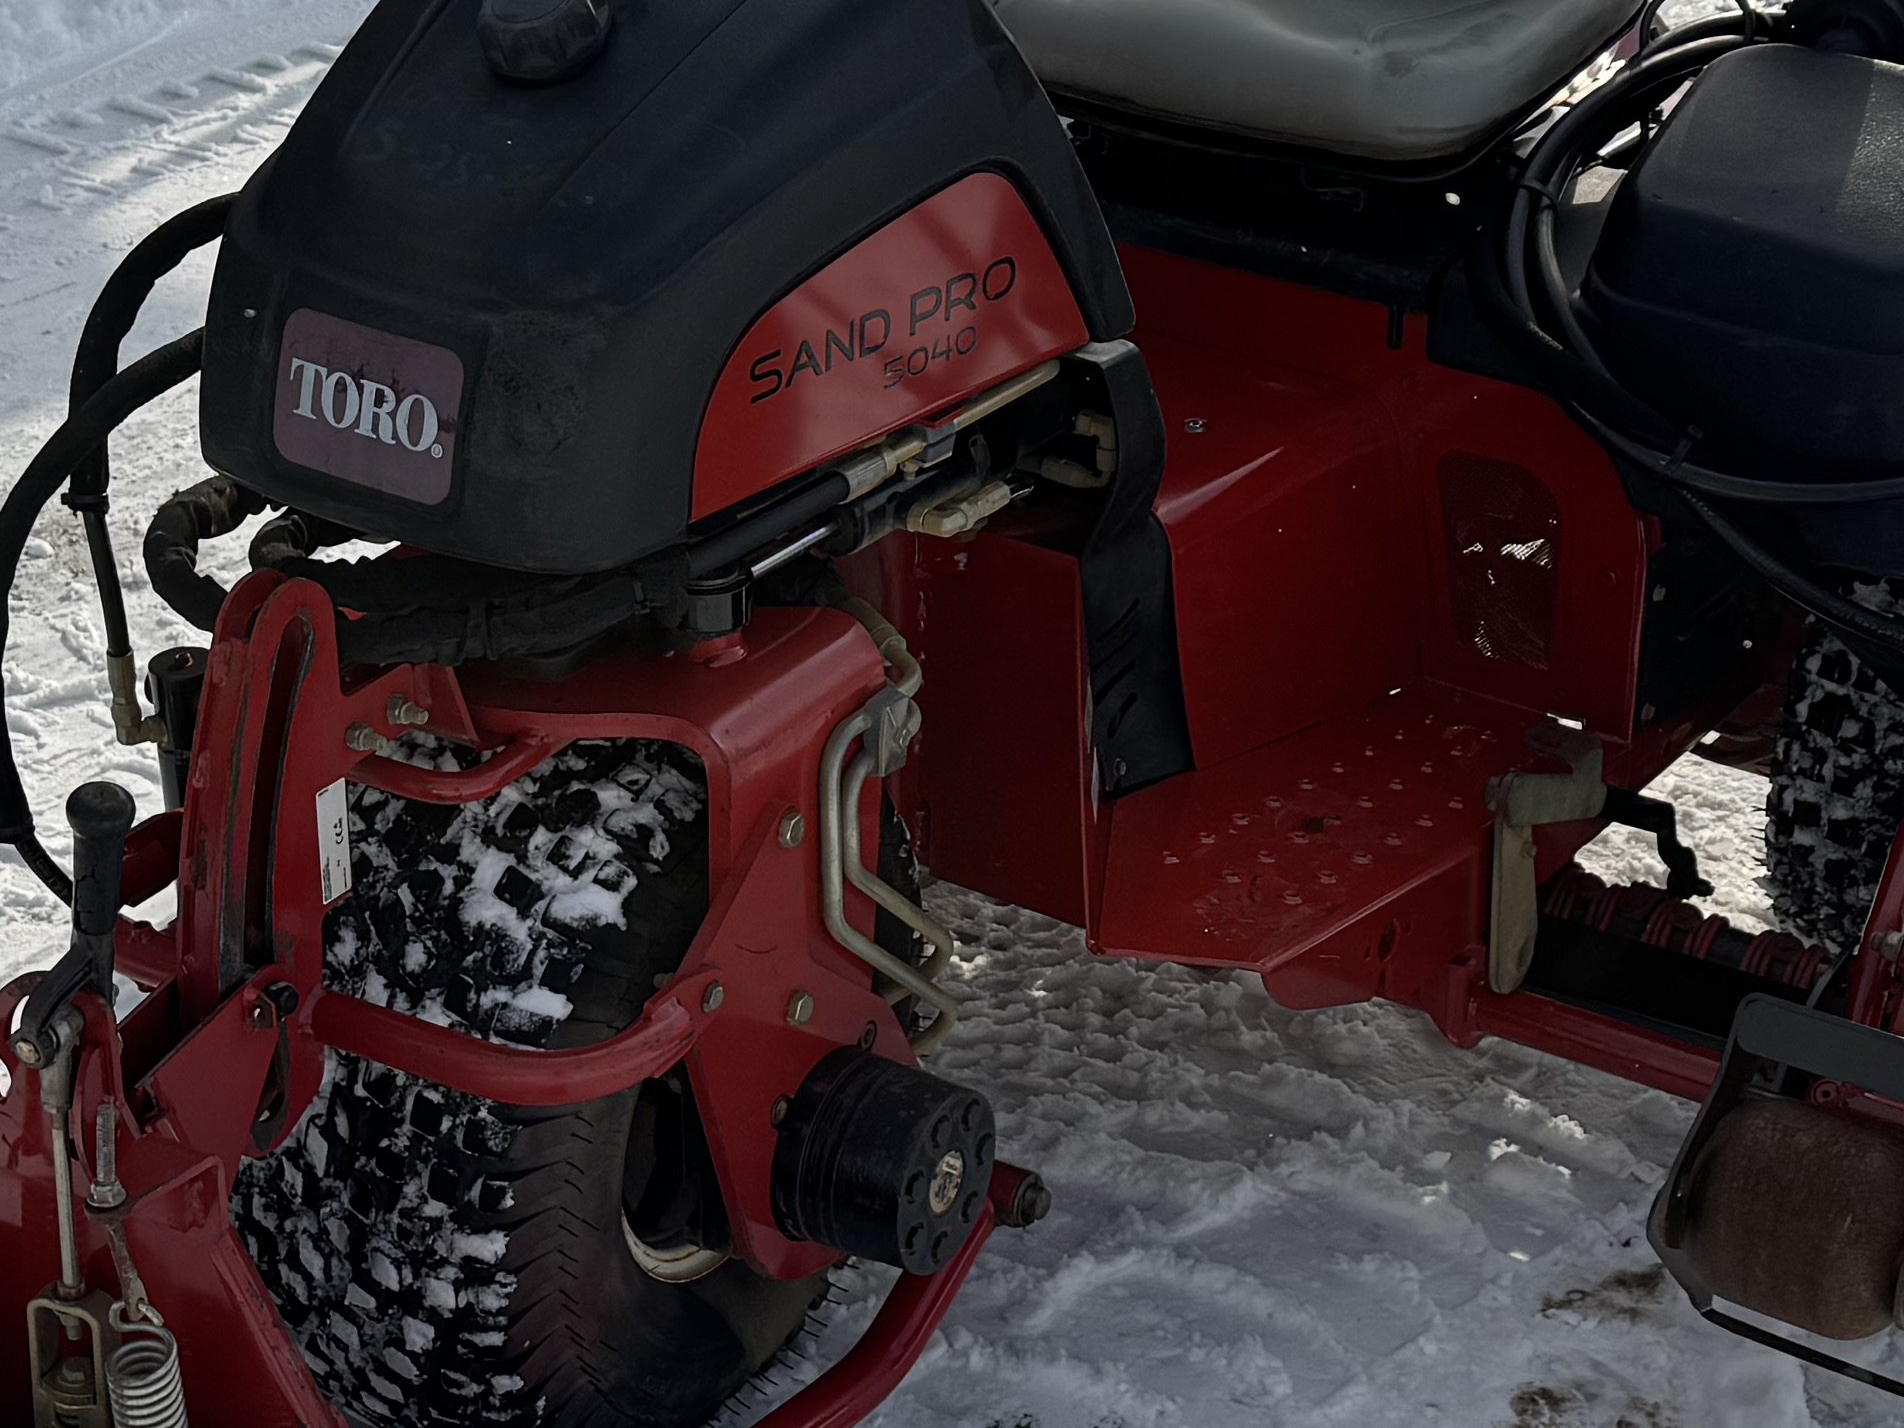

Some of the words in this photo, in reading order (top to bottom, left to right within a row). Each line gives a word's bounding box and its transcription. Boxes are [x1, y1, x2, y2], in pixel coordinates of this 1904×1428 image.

[749, 308, 891, 404] SAND
[909, 256, 1016, 336] PRO
[884, 327, 977, 390] 5040
